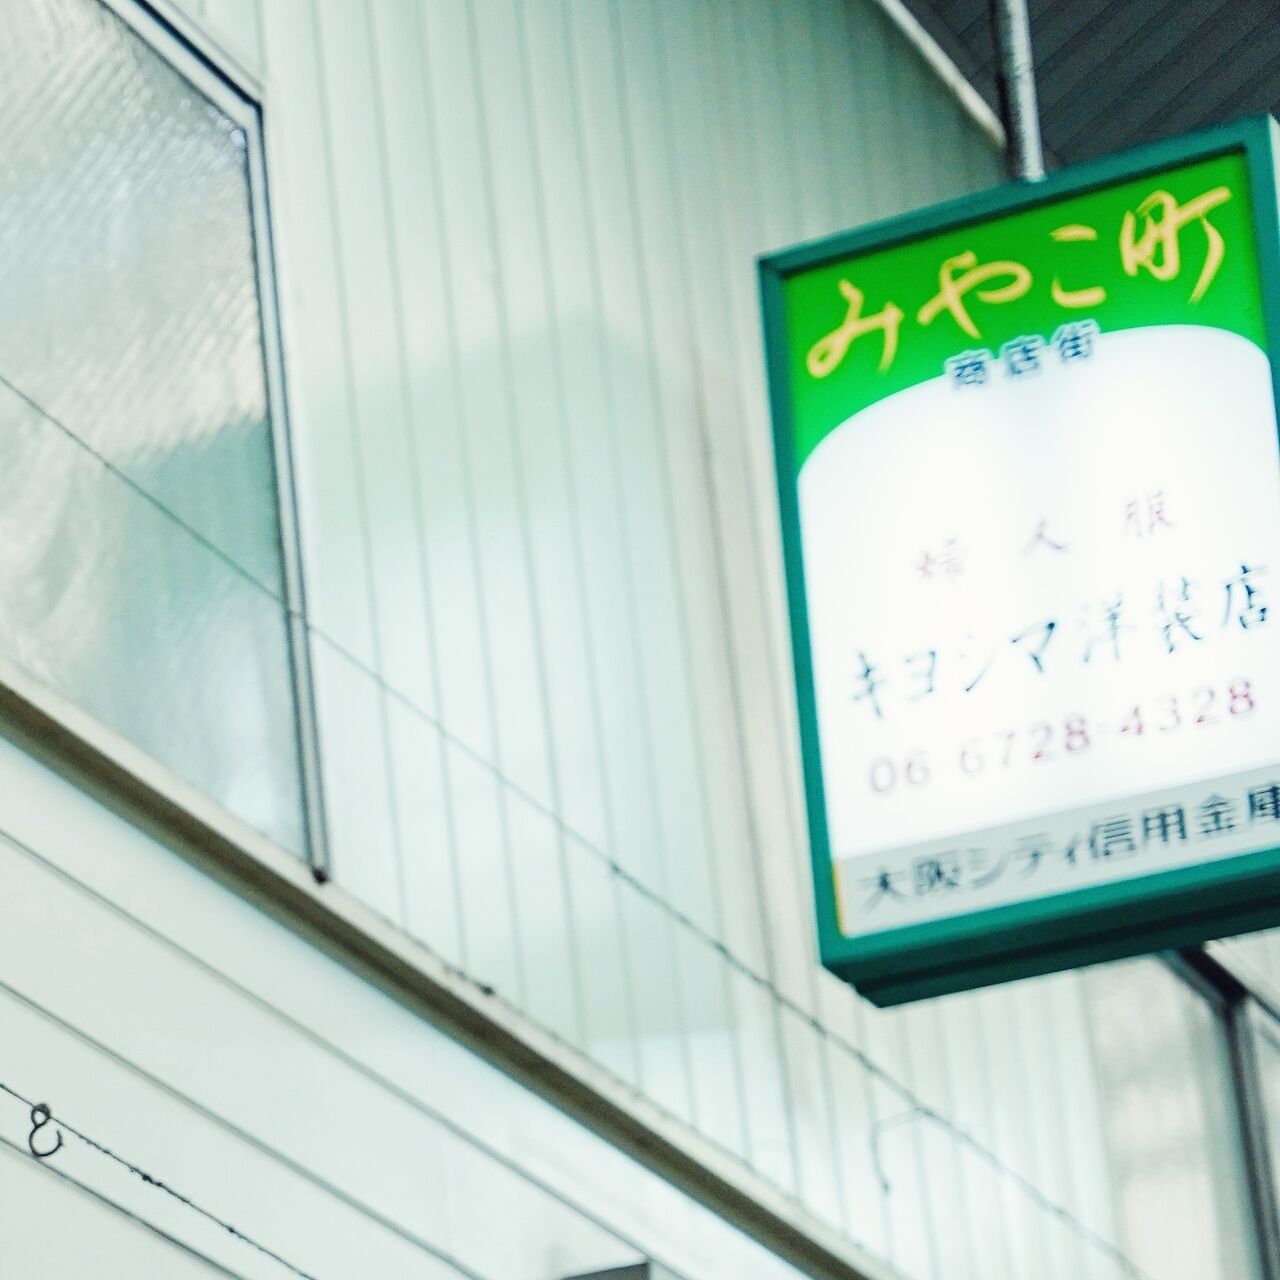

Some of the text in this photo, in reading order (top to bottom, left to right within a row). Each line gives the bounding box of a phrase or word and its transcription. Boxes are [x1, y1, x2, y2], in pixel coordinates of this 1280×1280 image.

[806, 186, 1232, 379] みやこ町
[947, 322, 1097, 389] 商店街
[914, 486, 1176, 586] 婦人服
[848, 560, 1271, 721] キヨシマ洋装店
[854, 782, 1280, 915] 大阪シティ信用金庫
